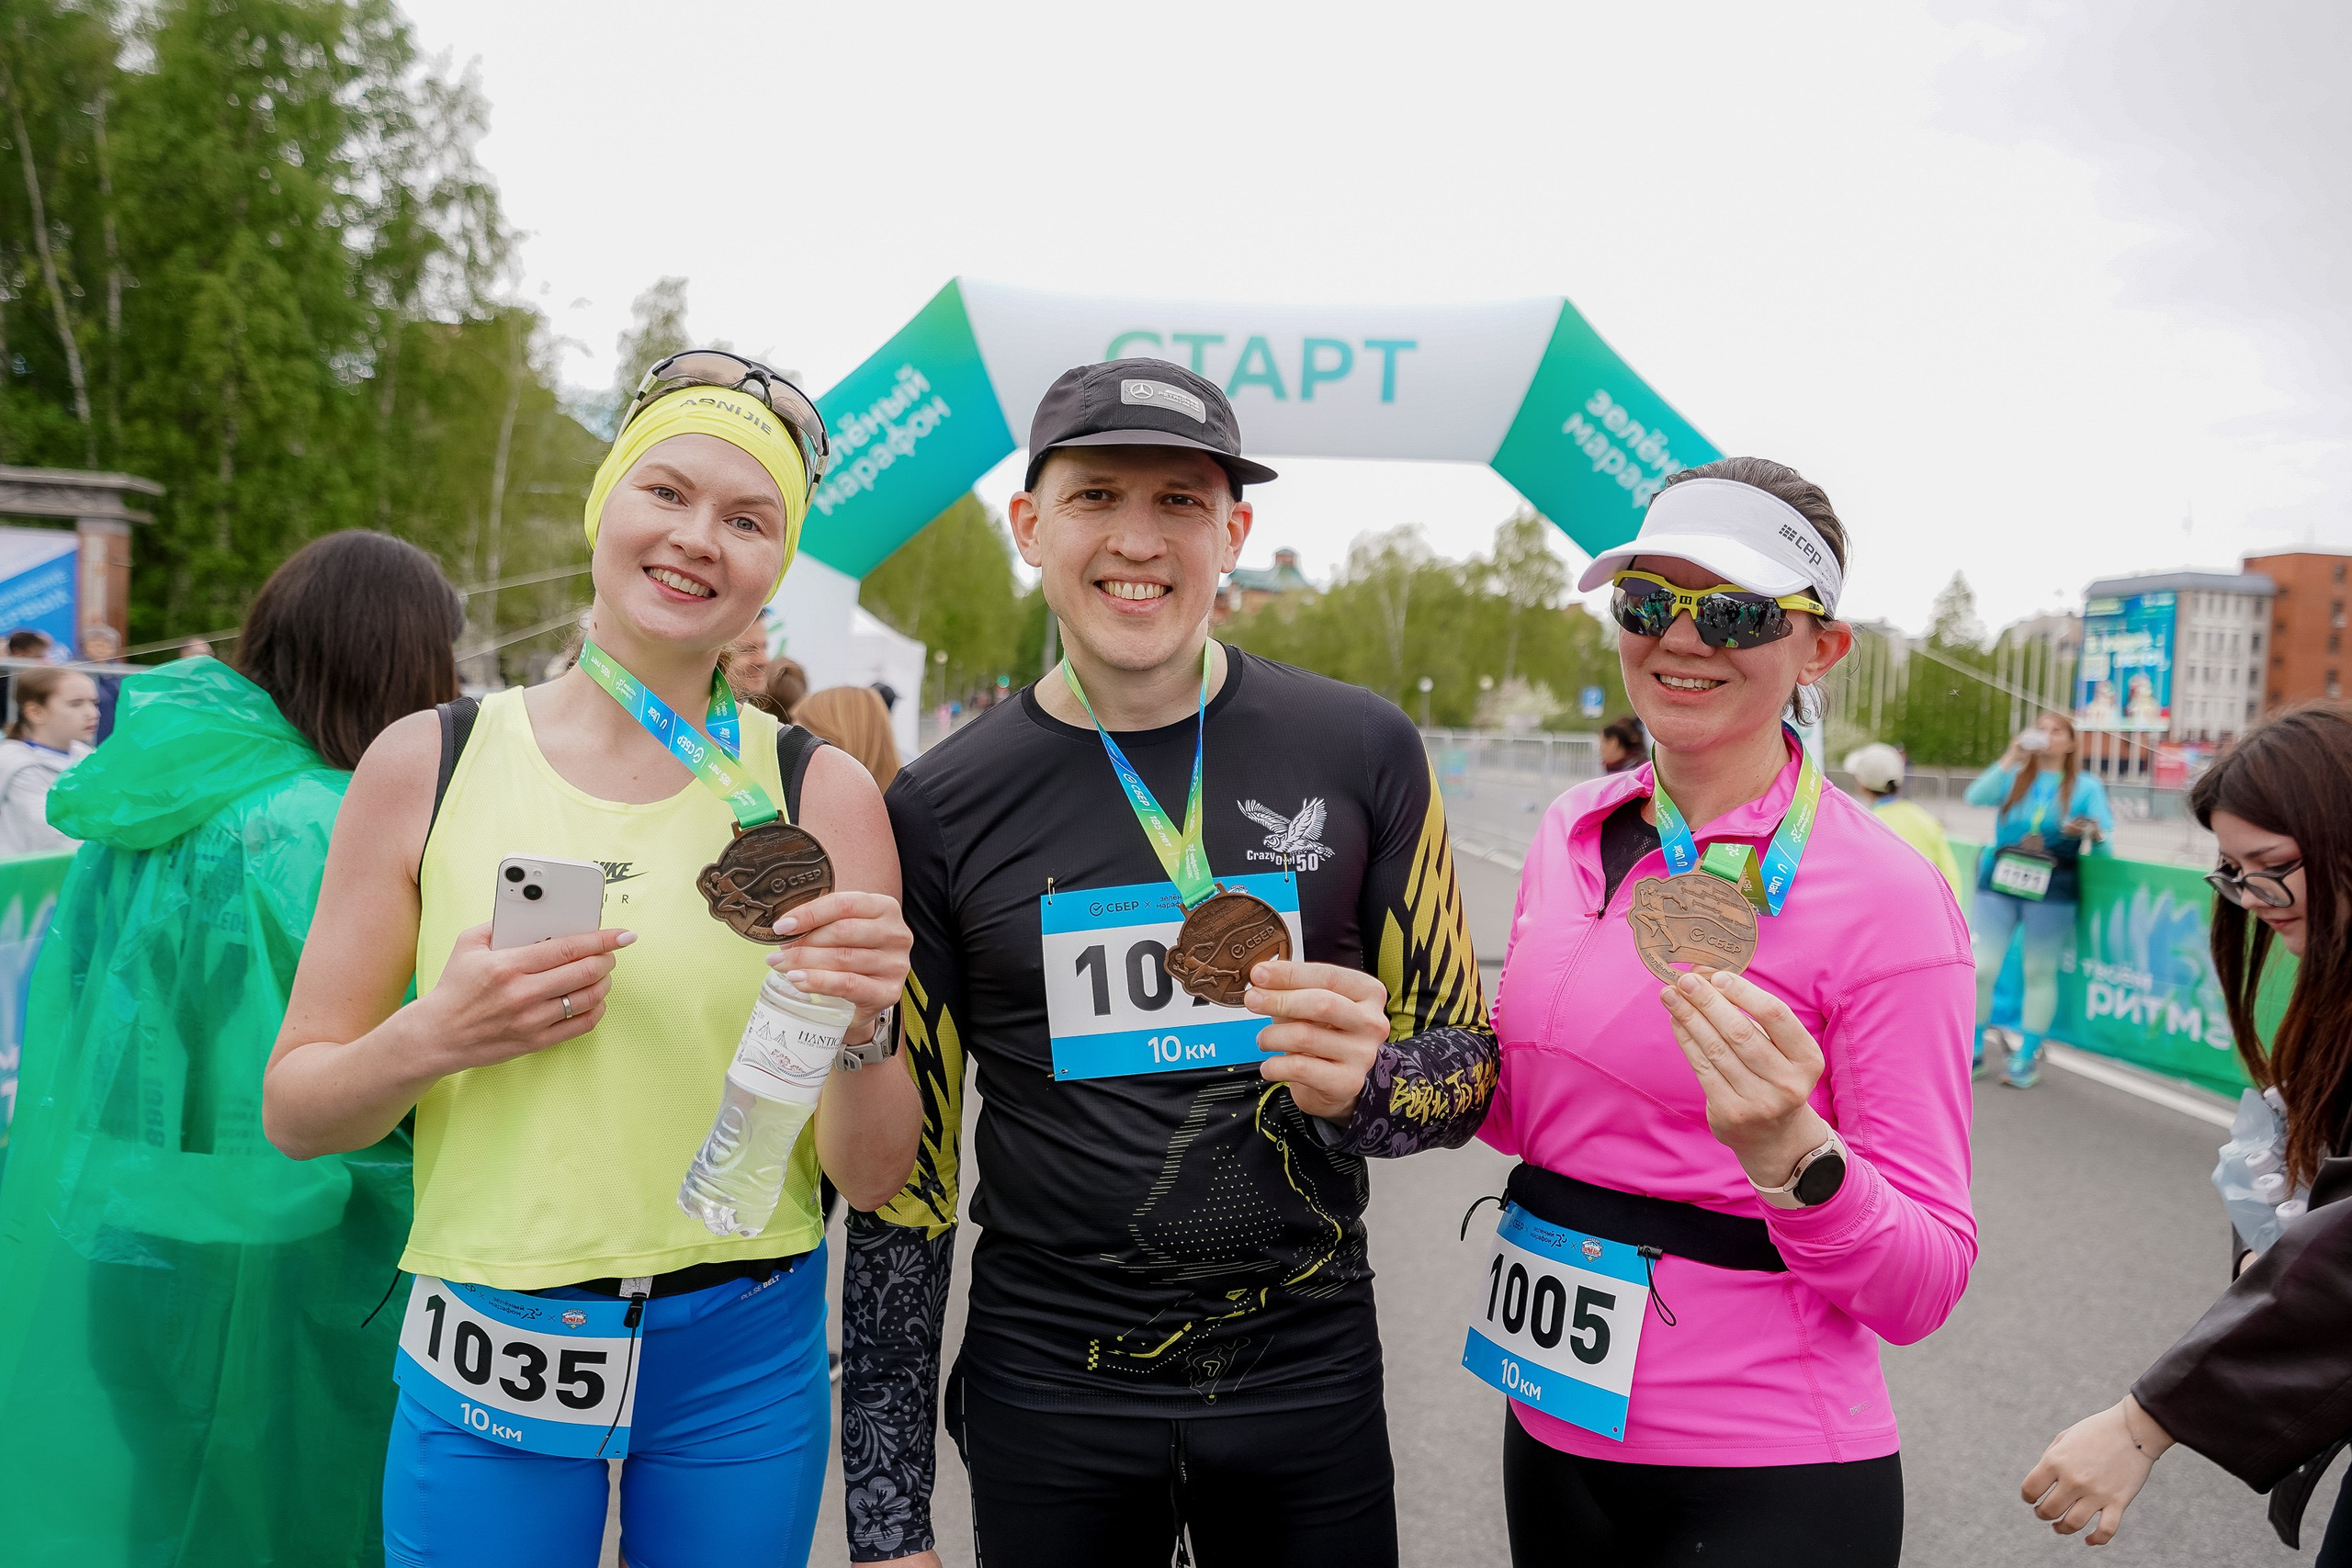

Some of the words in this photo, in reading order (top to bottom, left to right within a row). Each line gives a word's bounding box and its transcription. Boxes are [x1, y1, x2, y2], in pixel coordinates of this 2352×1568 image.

[680, 398, 772, 435] AONIJIE
[1585, 389, 1682, 479] зелён
[812, 395, 952, 516] марафон
[1562, 412, 1665, 509] мараф
[1794, 536, 1822, 567] cep
[676, 735, 695, 755] СБЕР
[708, 761, 722, 775] лет
[718, 773, 733, 787] 185
[1131, 784, 1150, 807] СБЕР
[1149, 815, 1164, 830] 185
[1158, 831, 1173, 848] лет
[1246, 850, 1275, 862] Crazy
[1296, 852, 1319, 872] 50
[788, 869, 821, 886] СБЕР
[1768, 875, 1784, 896] Utair
[1106, 900, 1139, 913] СБЕР
[1156, 900, 1181, 909] мараф
[1159, 894, 1182, 902] зелён
[1246, 925, 1275, 949] СБЕР
[1707, 936, 1742, 953] СБЕР
[1075, 939, 1211, 1017] 10
[763, 1274, 780, 1289] BELT
[489, 1302, 521, 1316] марафон
[492, 1297, 525, 1311] зелёный
[1487, 1251, 1617, 1365] 1005
[424, 1293, 608, 1411] 1035
